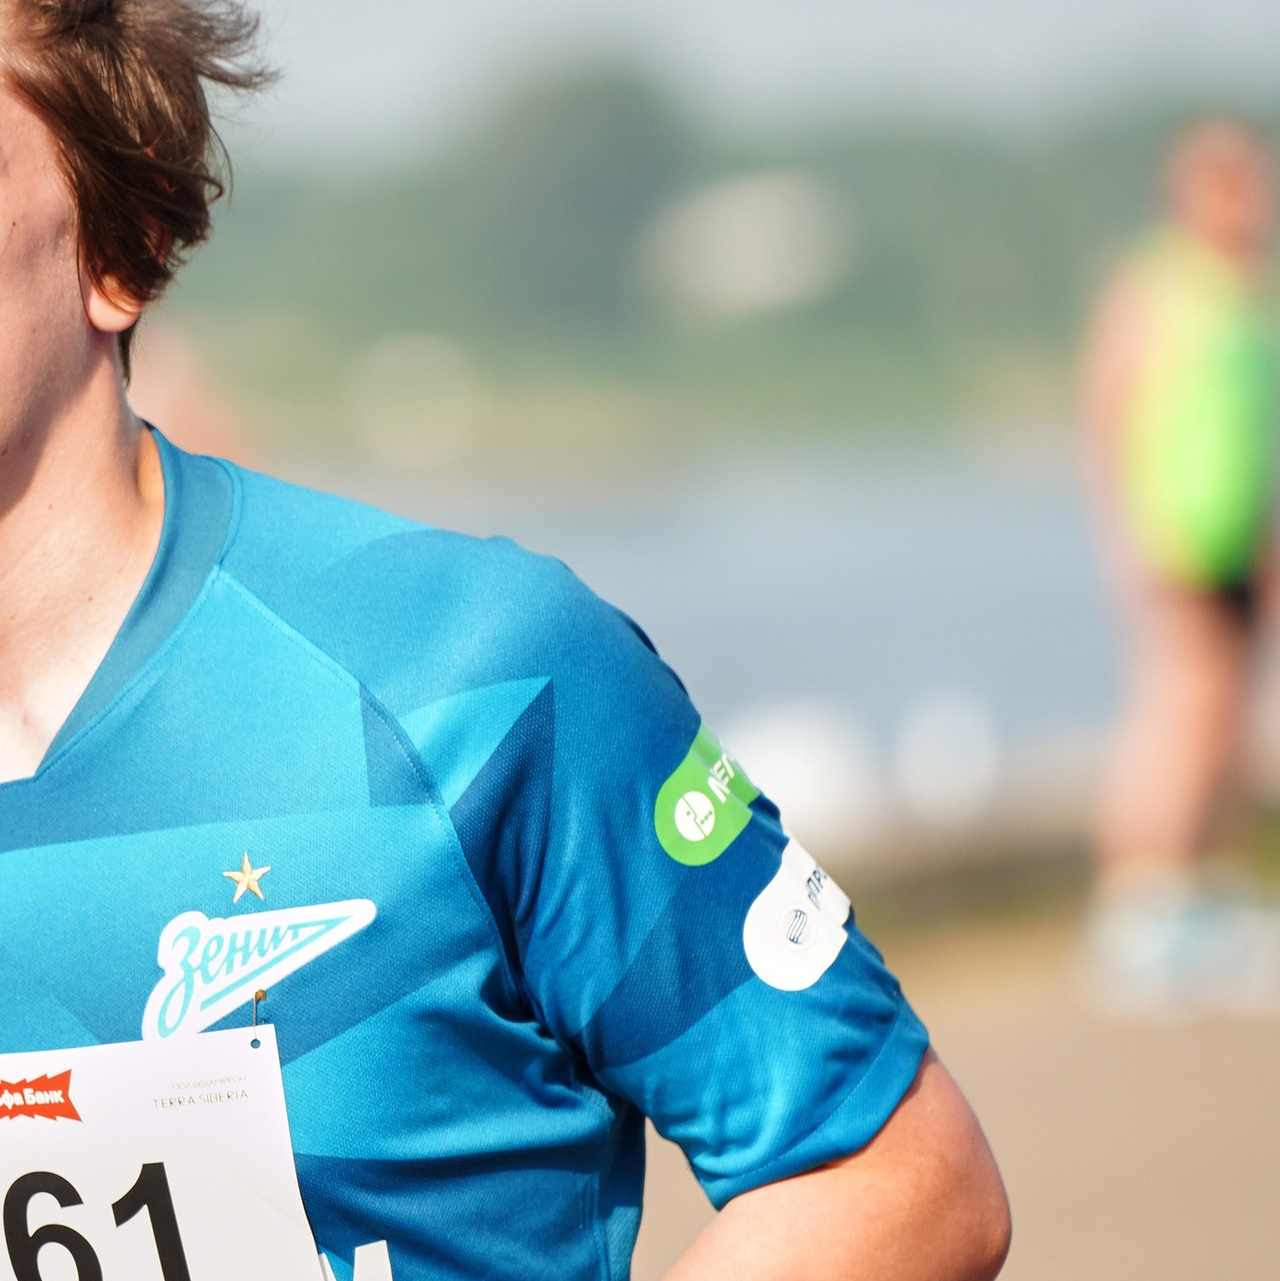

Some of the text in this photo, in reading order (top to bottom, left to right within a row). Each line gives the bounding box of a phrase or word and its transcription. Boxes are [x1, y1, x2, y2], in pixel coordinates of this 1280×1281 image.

[157, 921, 320, 1038] Зенит
[23, 1088, 65, 1106] Банк
[152, 1089, 249, 1109] TERRA SIBERIA
